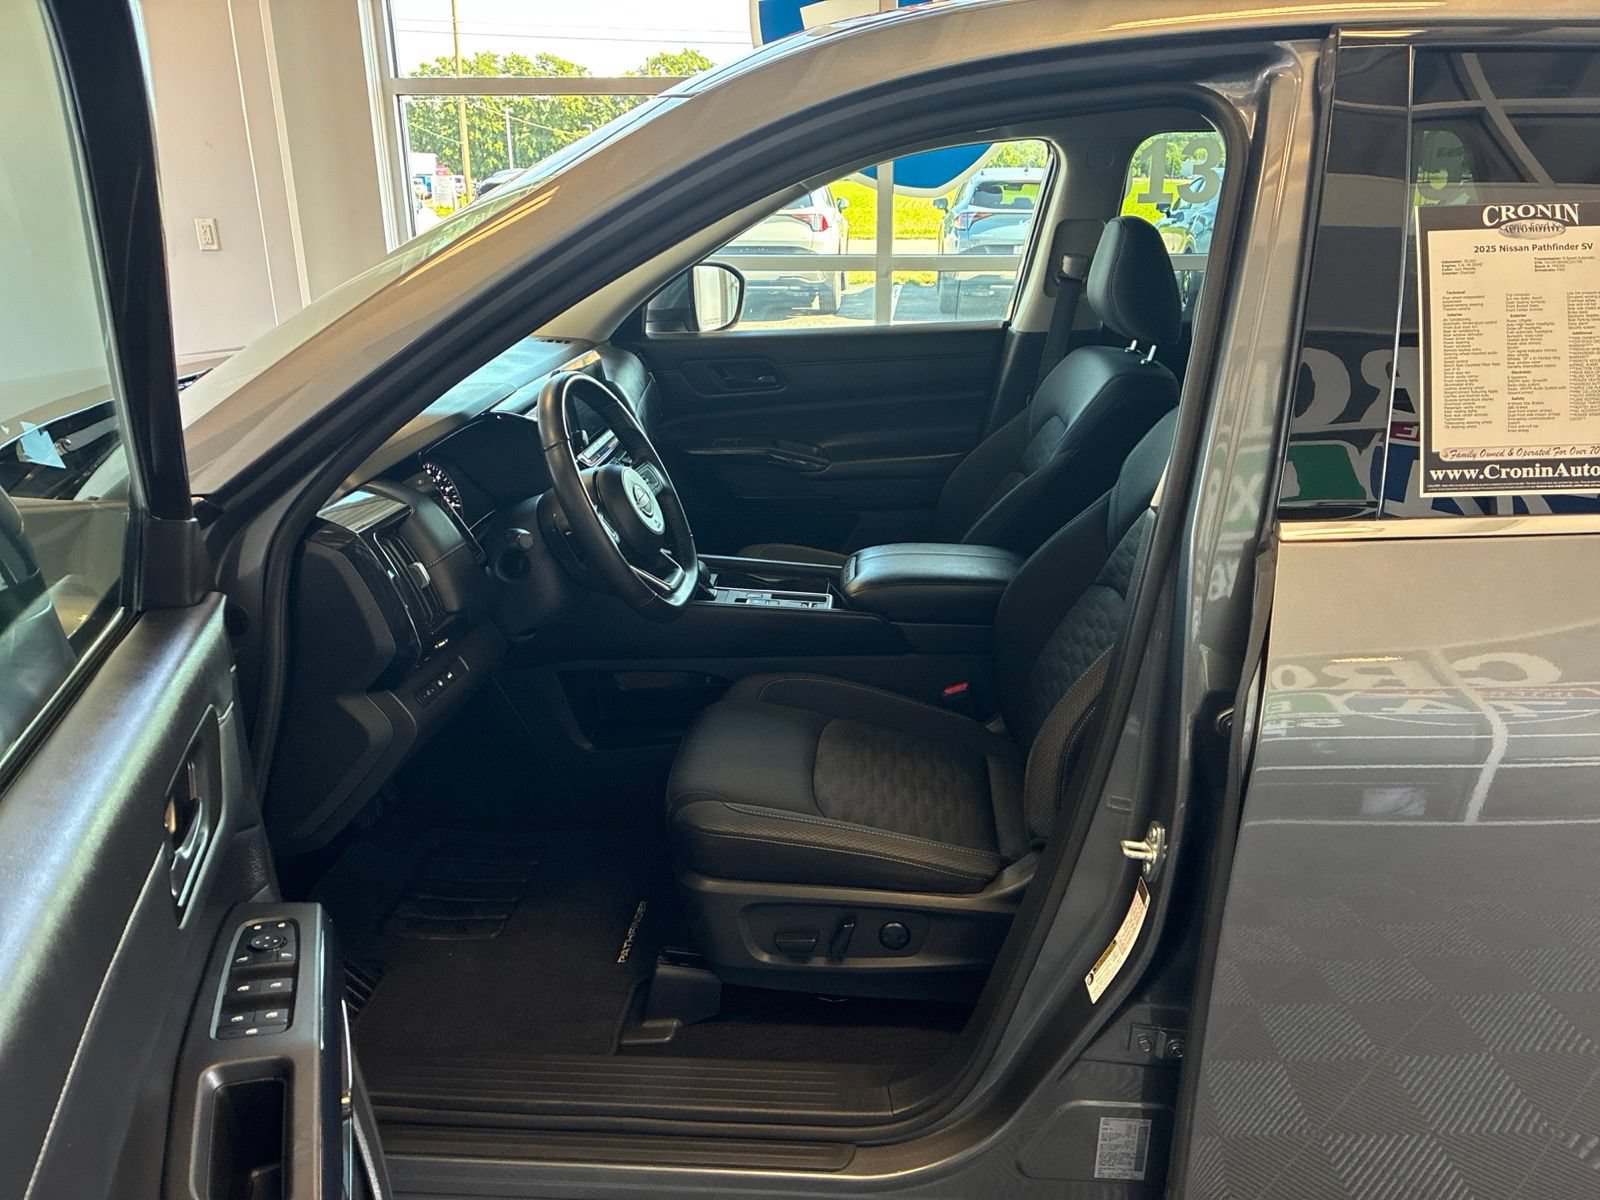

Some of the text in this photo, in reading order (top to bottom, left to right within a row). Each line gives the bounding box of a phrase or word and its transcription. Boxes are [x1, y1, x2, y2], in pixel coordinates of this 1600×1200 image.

[1482, 204, 1579, 226] CRONIN
[1532, 243, 1579, 251] Pathfinder
[1450, 450, 1476, 460] Family
[1480, 448, 1505, 458] Owned
[1508, 448, 1513, 456] &
[1516, 447, 1550, 458] Operated
[1553, 446, 1566, 456] For
[1570, 446, 1587, 455] Over
[1430, 462, 1600, 481] www.CroninAuto
